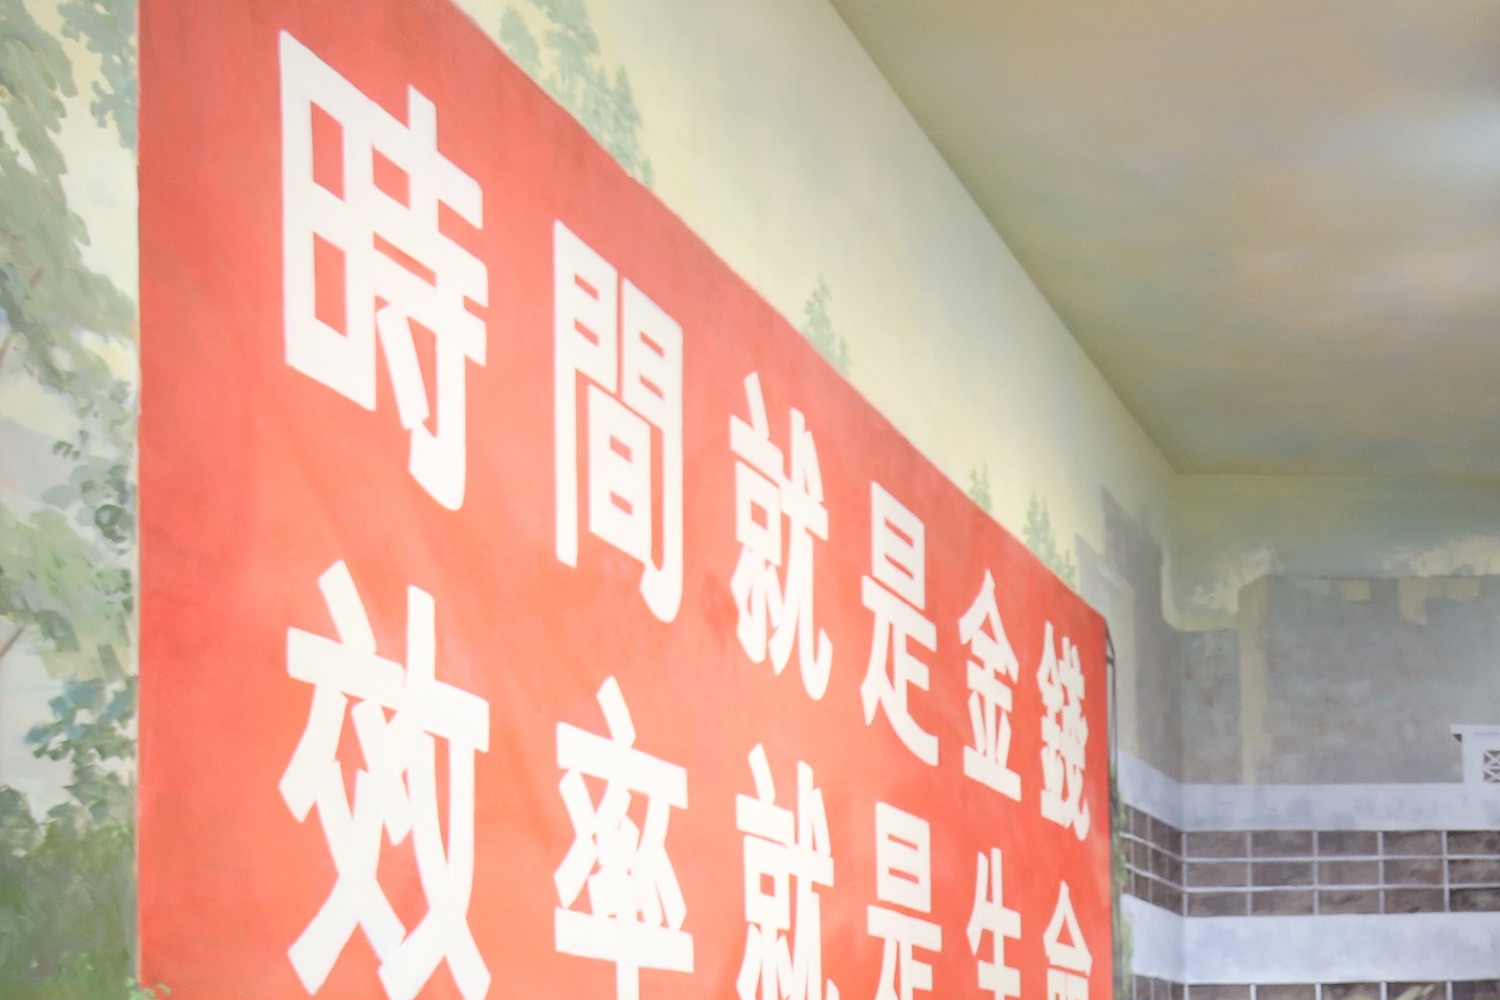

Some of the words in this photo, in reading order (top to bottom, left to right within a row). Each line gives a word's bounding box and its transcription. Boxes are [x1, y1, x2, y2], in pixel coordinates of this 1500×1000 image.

[278, 31, 1091, 841] 時間就是金錢
